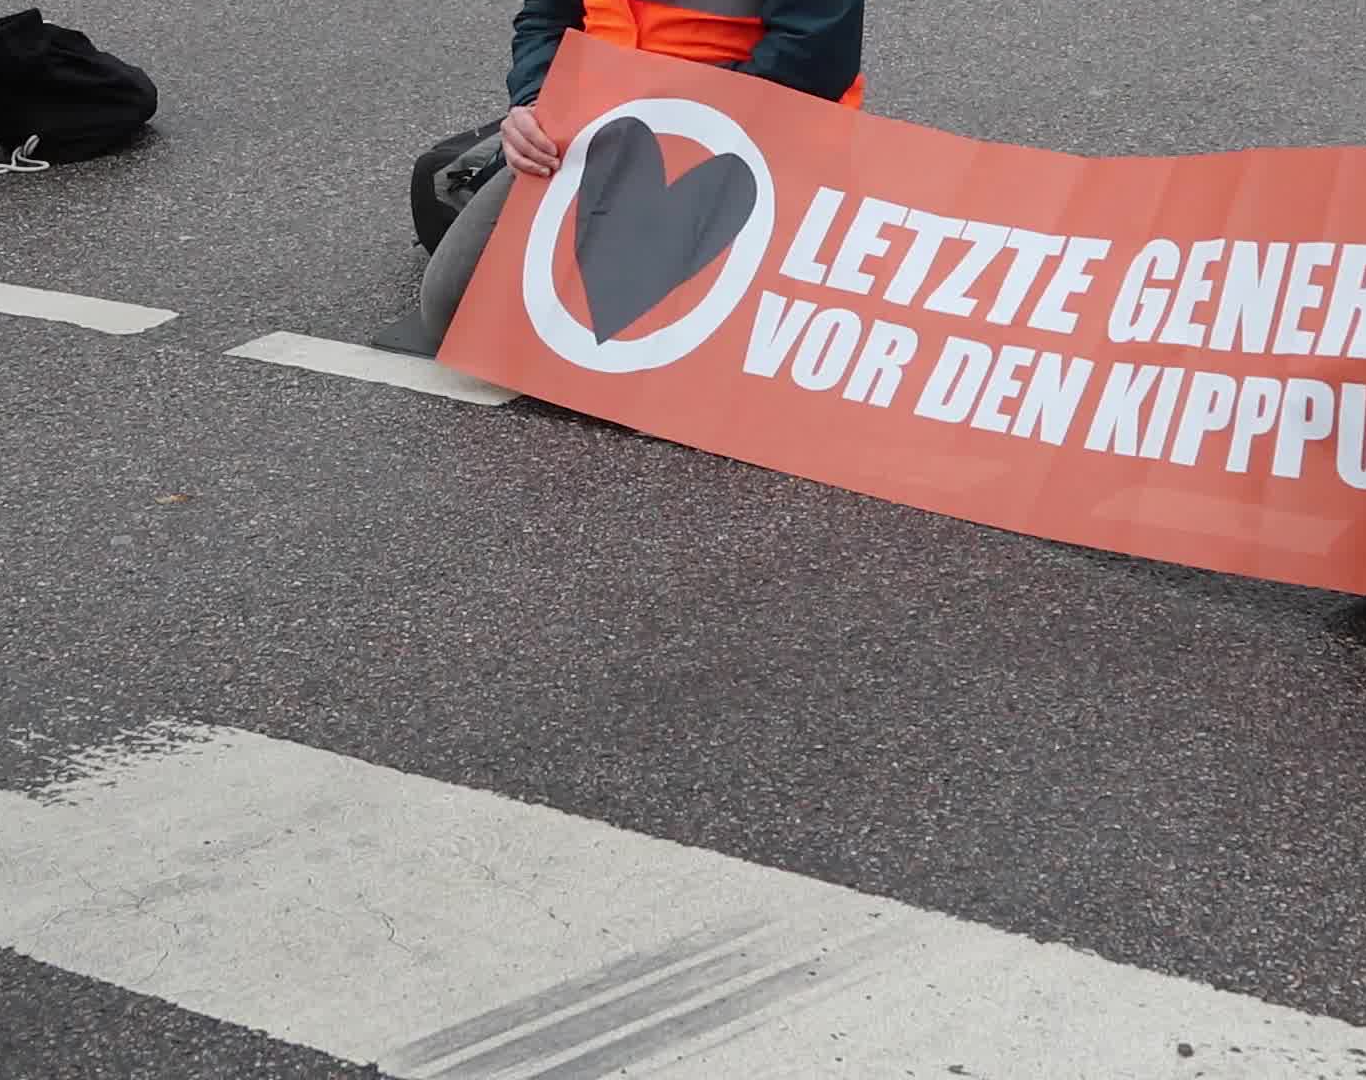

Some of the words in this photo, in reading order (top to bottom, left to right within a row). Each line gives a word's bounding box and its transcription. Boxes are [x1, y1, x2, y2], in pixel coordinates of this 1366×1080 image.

[778, 185, 1112, 335] LETZTE
[741, 290, 919, 409] VOR
[912, 335, 1095, 447] DEN
